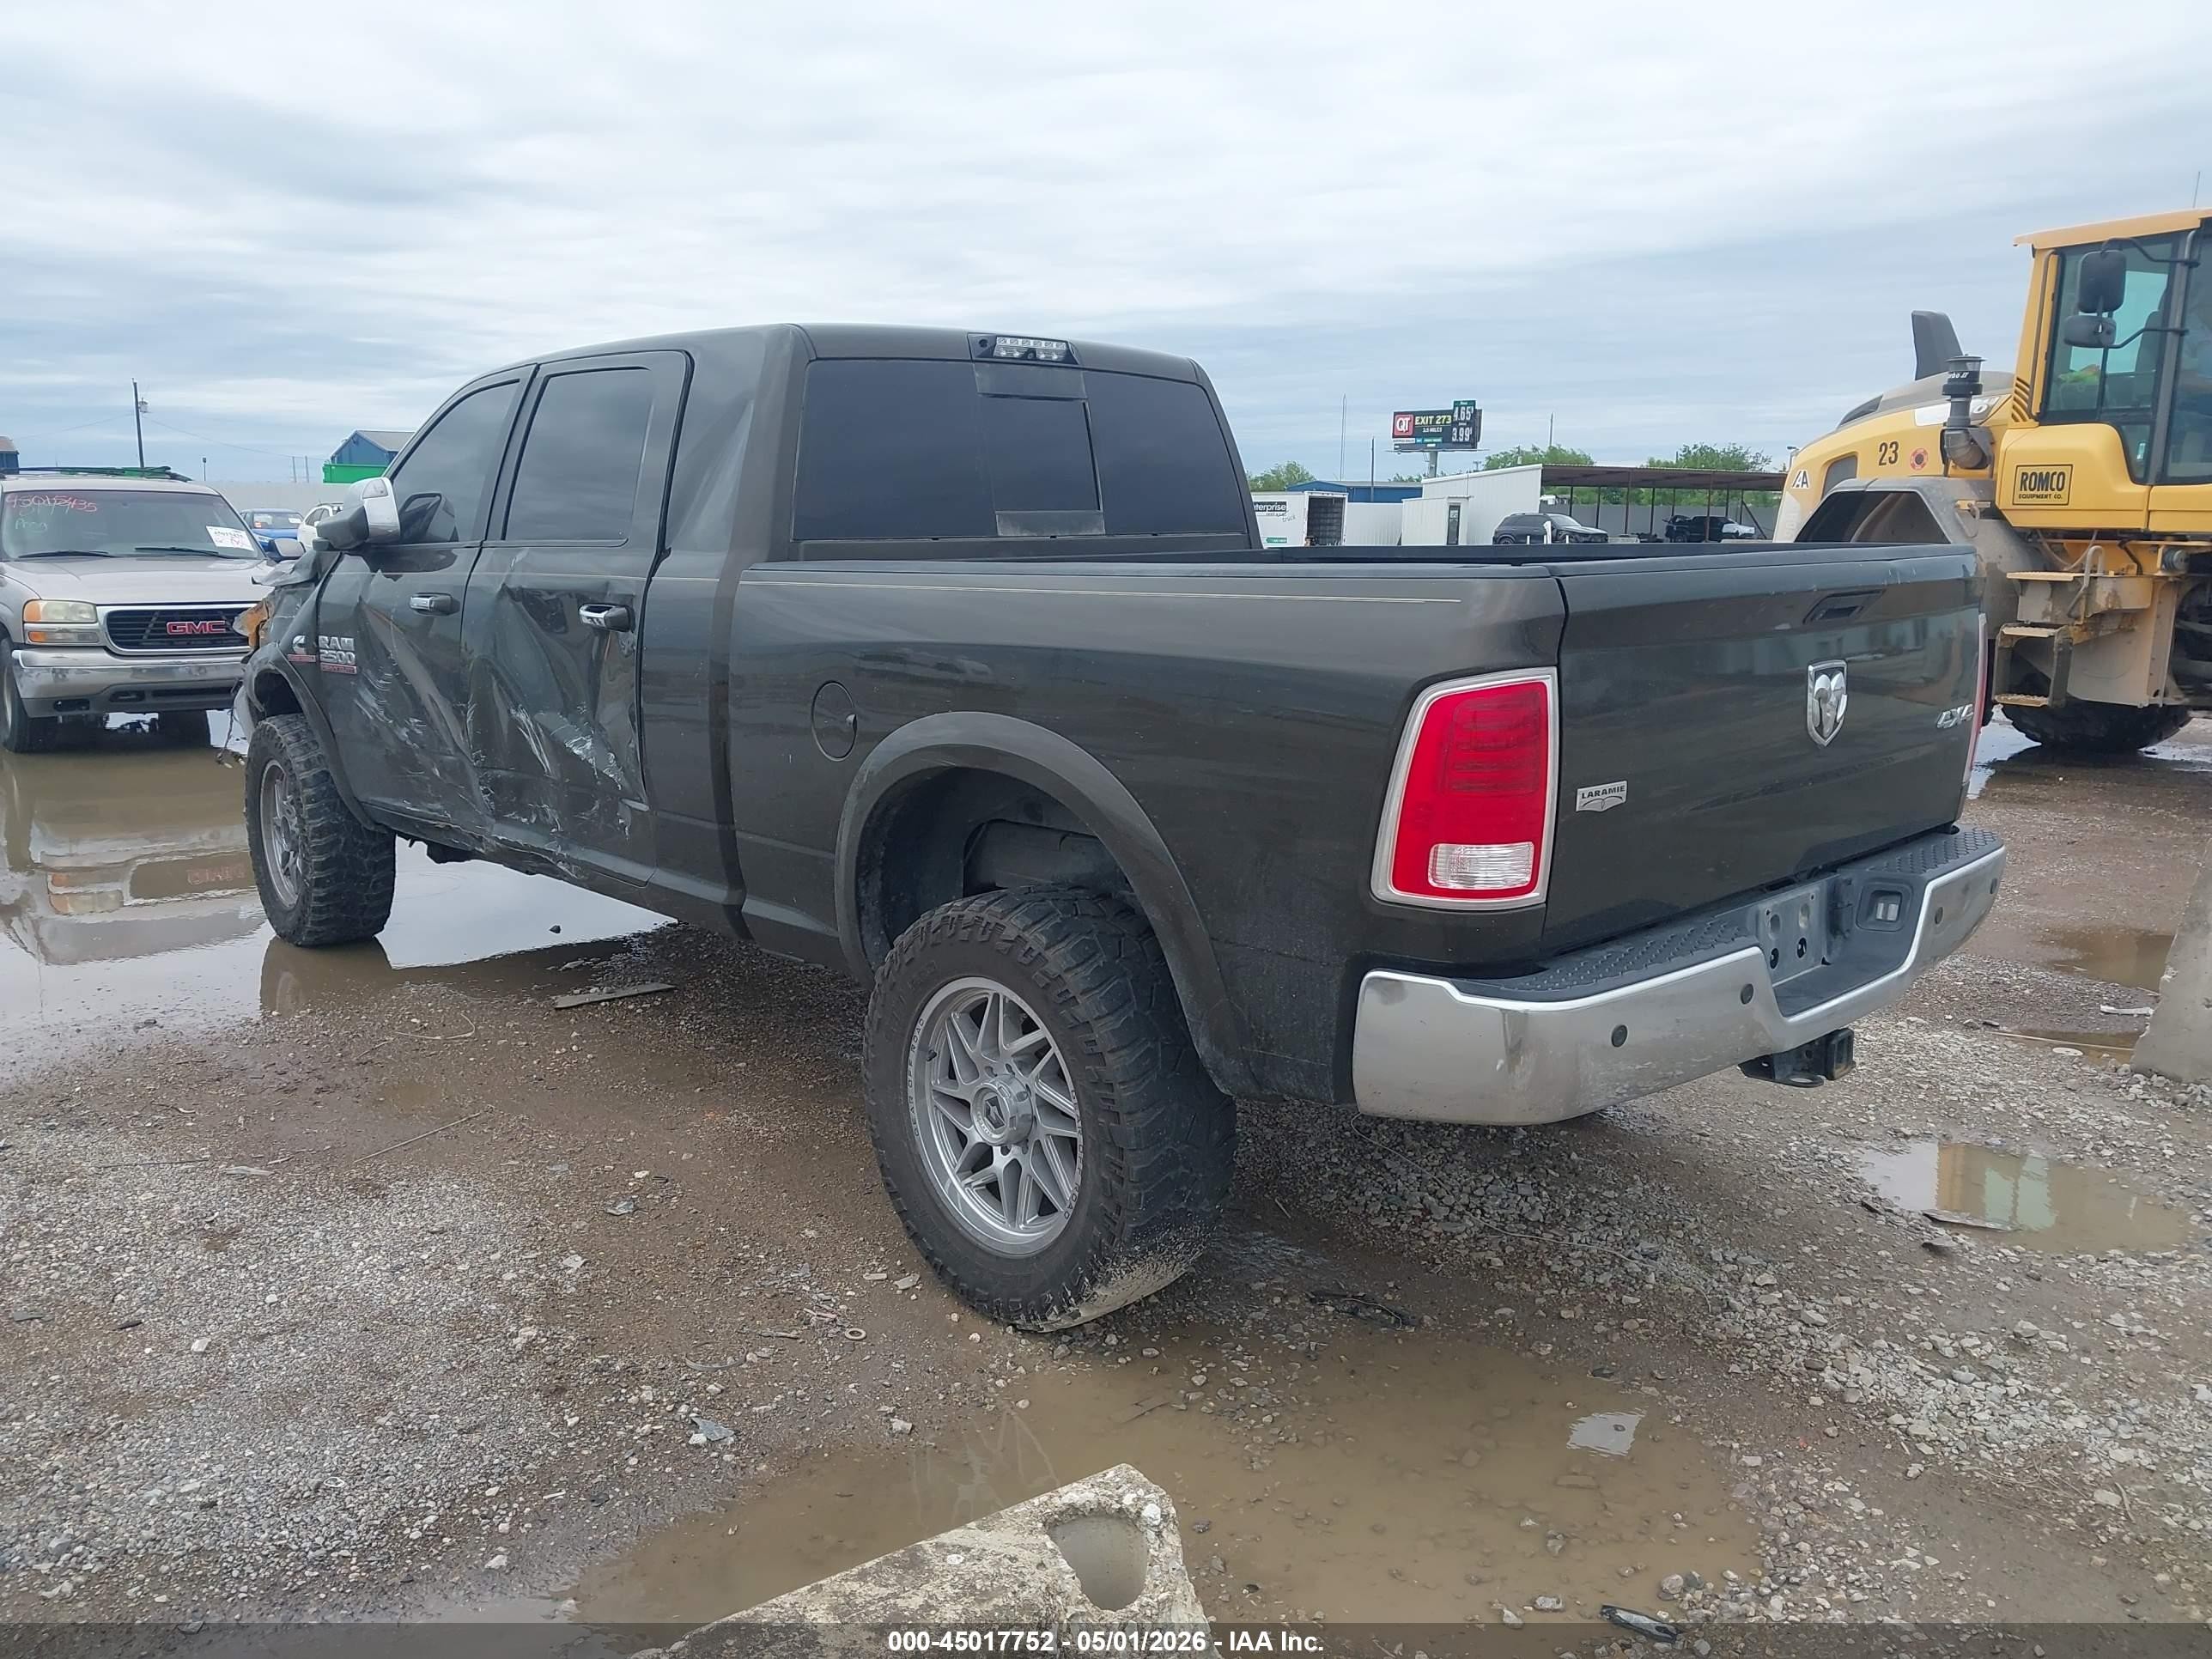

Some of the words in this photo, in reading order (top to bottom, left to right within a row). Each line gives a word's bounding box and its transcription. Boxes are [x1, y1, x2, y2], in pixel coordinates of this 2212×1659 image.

[1395, 417, 1410, 433] QT
[1414, 416, 1434, 426] EXIT
[1435, 415, 1452, 425] 273
[1878, 441, 1899, 466] 23
[2020, 471, 2066, 492] ROMCO
[167, 621, 227, 635] GMC
[318, 635, 356, 652] RAM
[319, 649, 356, 665] 2500
[1582, 785, 1626, 799] LARAMIE
[910, 1018, 925, 1053] ROAD
[1063, 1182, 1080, 1219] ROAD
